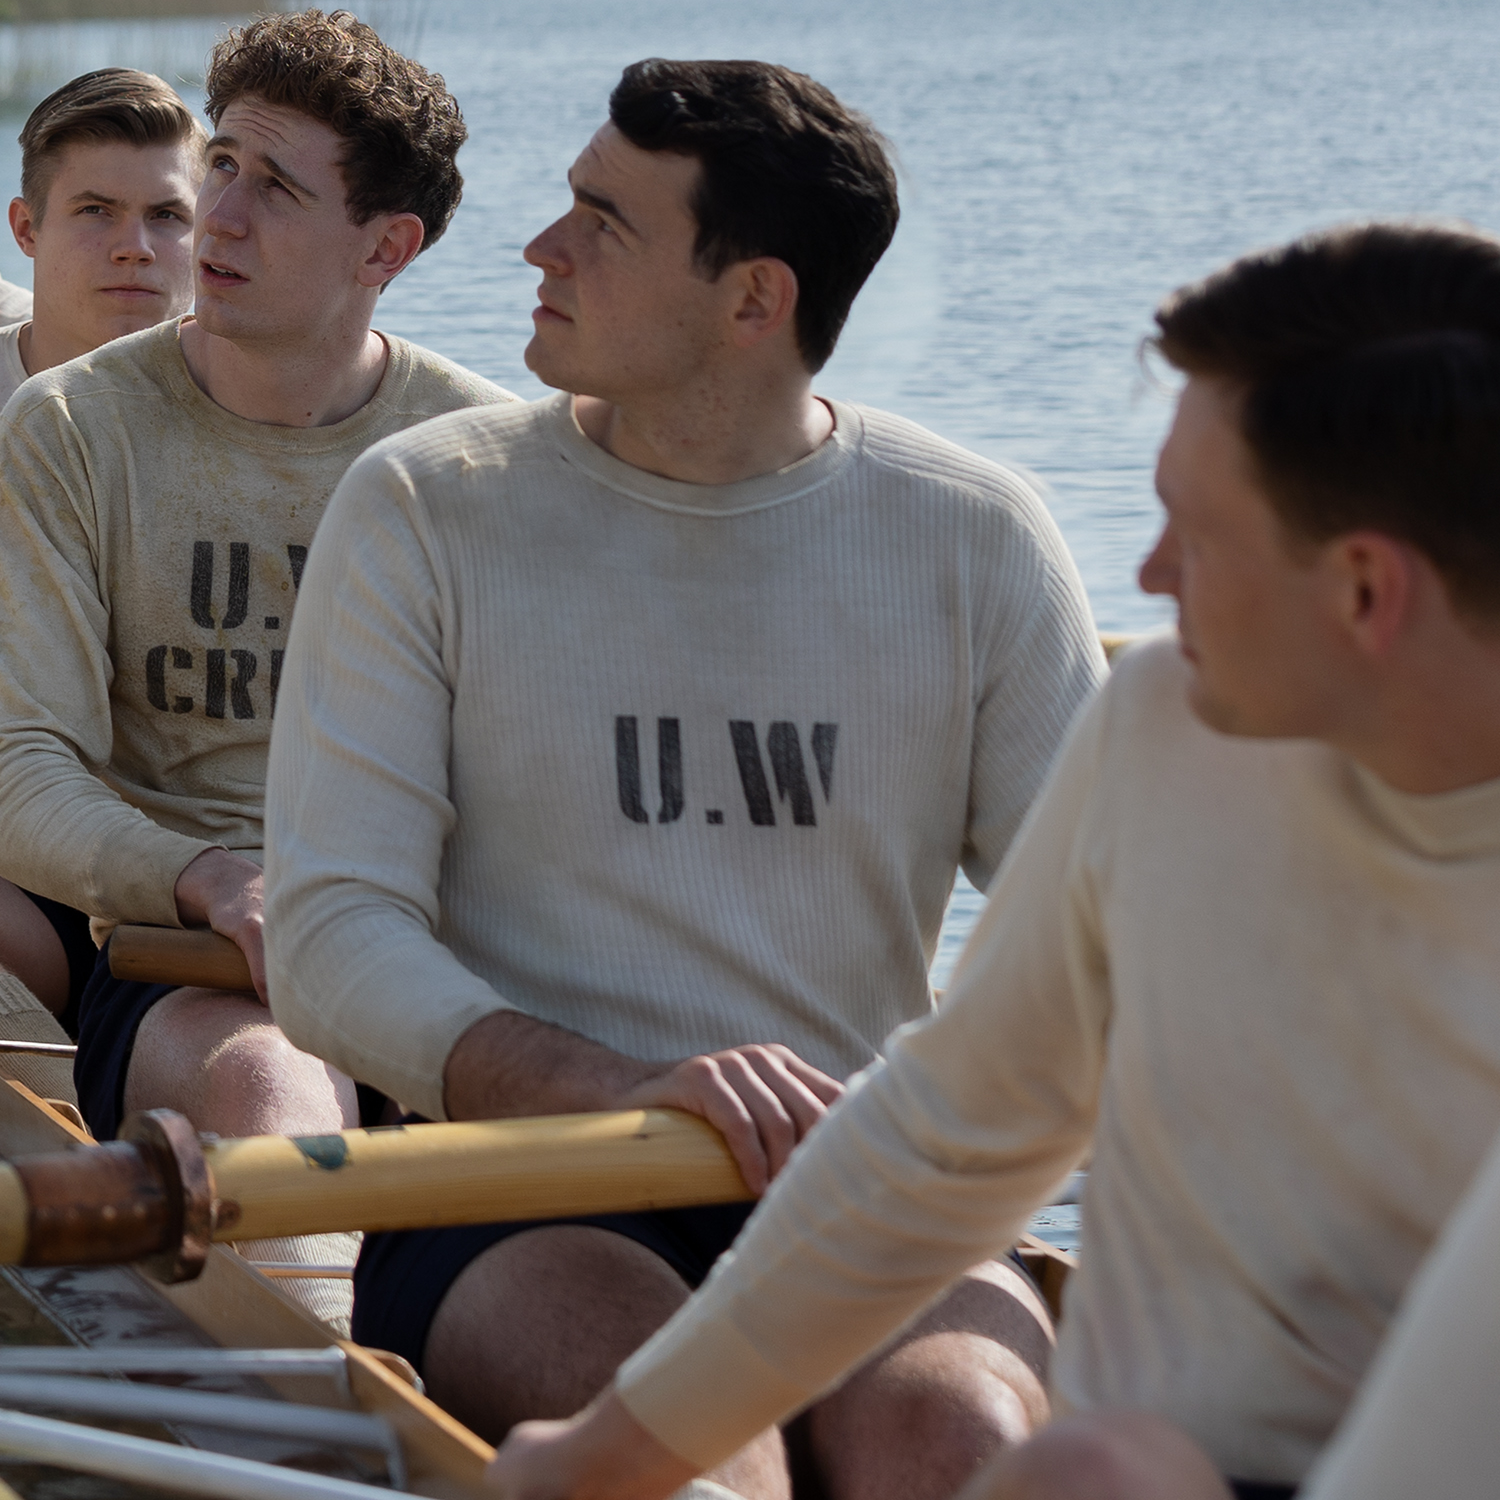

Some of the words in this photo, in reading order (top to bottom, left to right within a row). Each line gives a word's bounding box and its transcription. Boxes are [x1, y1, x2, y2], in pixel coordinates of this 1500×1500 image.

[190, 541, 307, 630] U.
[146, 645, 285, 720] CR
[615, 715, 838, 826] U.W
